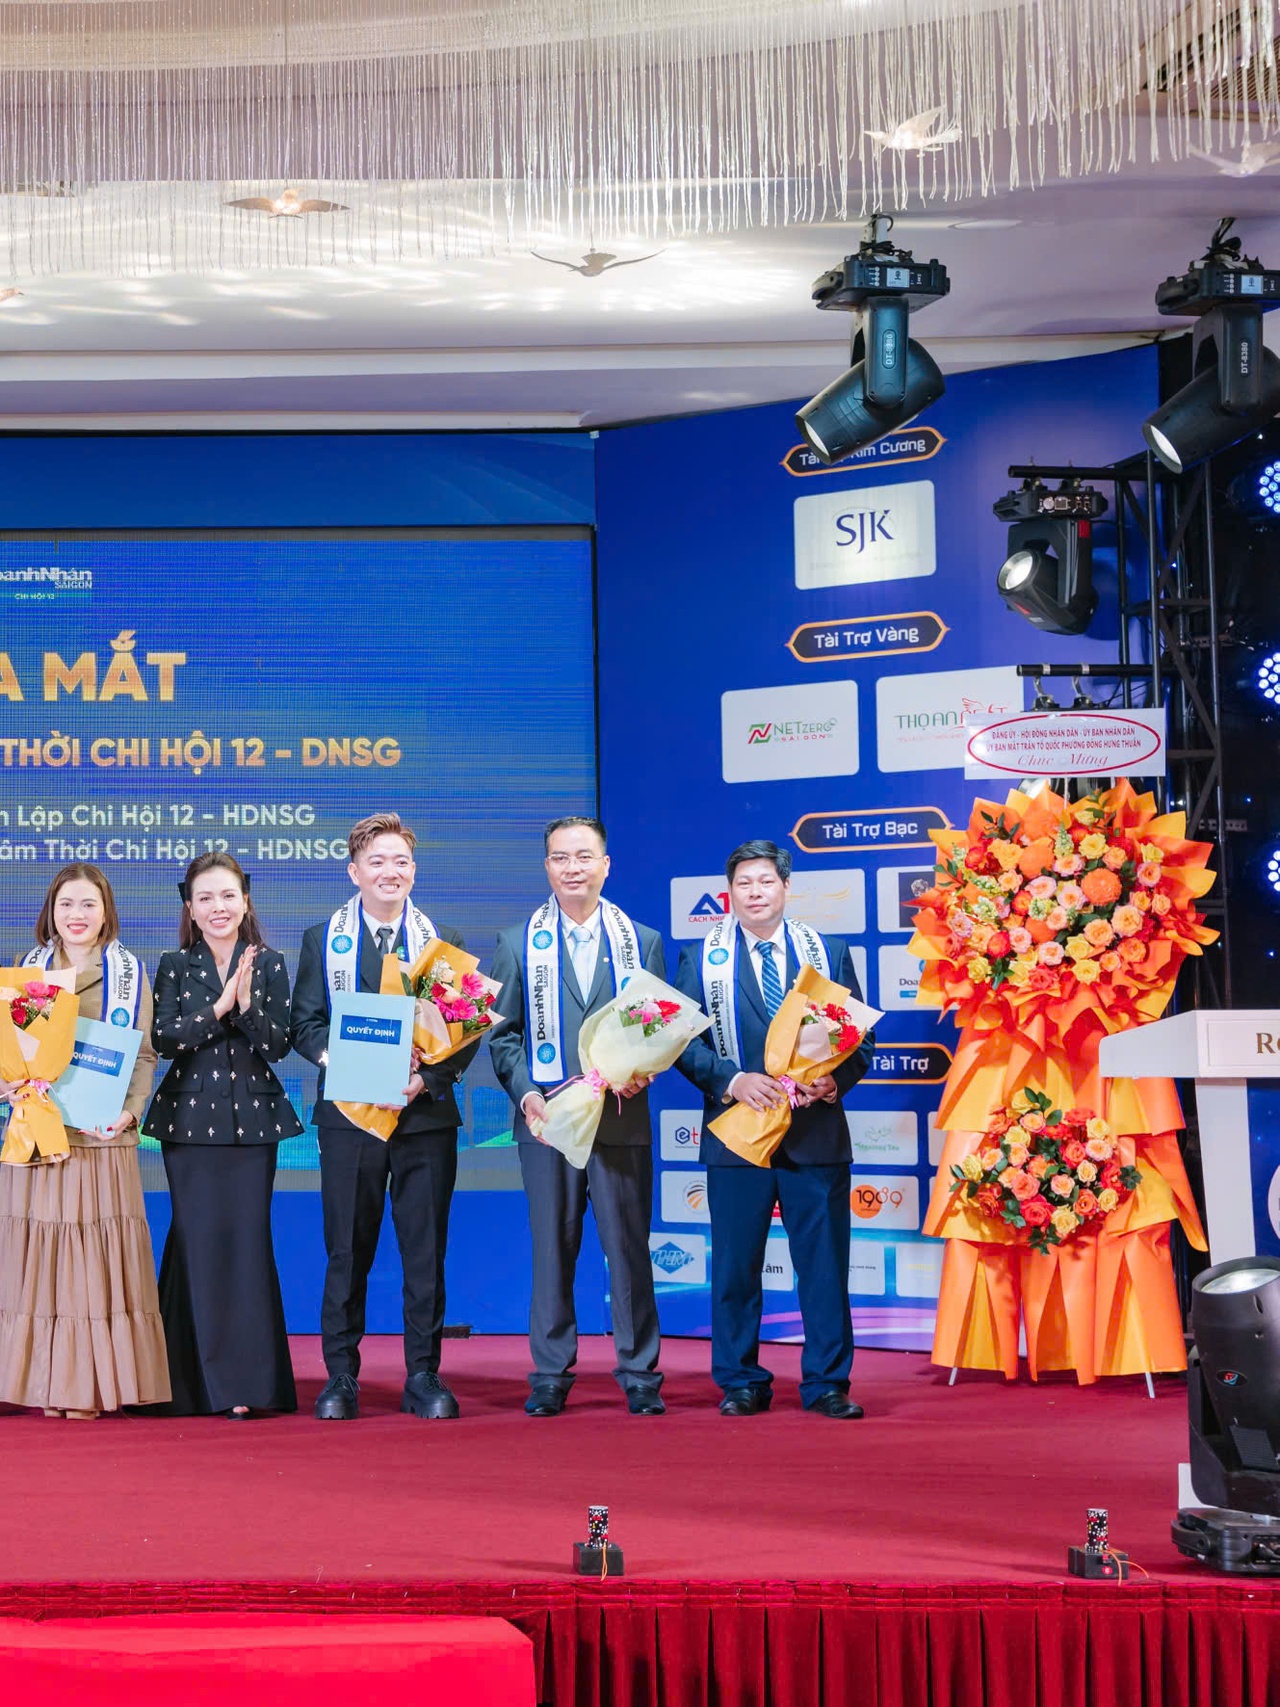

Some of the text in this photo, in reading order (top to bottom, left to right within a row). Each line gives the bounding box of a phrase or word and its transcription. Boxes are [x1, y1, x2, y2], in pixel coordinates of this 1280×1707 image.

[1241, 341, 1249, 374] DT-8380
[880, 439, 926, 455] Cương
[835, 509, 894, 554] SJK
[54, 581, 93, 590] SAIGON
[814, 626, 920, 648] Tài Trợ Vàng
[43, 630, 186, 701] MẮT
[90, 738, 149, 766] CHI
[160, 730, 220, 775] HỘI
[231, 738, 266, 766] 12
[302, 737, 401, 766] DNSG
[17, 804, 64, 832] Lập
[71, 804, 114, 826] Chi
[122, 804, 162, 832] Hội
[170, 804, 195, 826] 12
[223, 804, 316, 826] HDNSG
[822, 821, 918, 840] Tài Trợ Bạc
[43, 838, 95, 860] Thời
[106, 839, 148, 860] Chi
[156, 838, 196, 867] Hội
[203, 838, 229, 853] 12
[257, 838, 350, 860] HDNSG
[347, 1025, 395, 1038] QUYẾT ĐỊNH
[1256, 1032, 1280, 1054] R
[73, 1050, 97, 1064] QUYẾT
[872, 1055, 929, 1073] Tài Trợ
